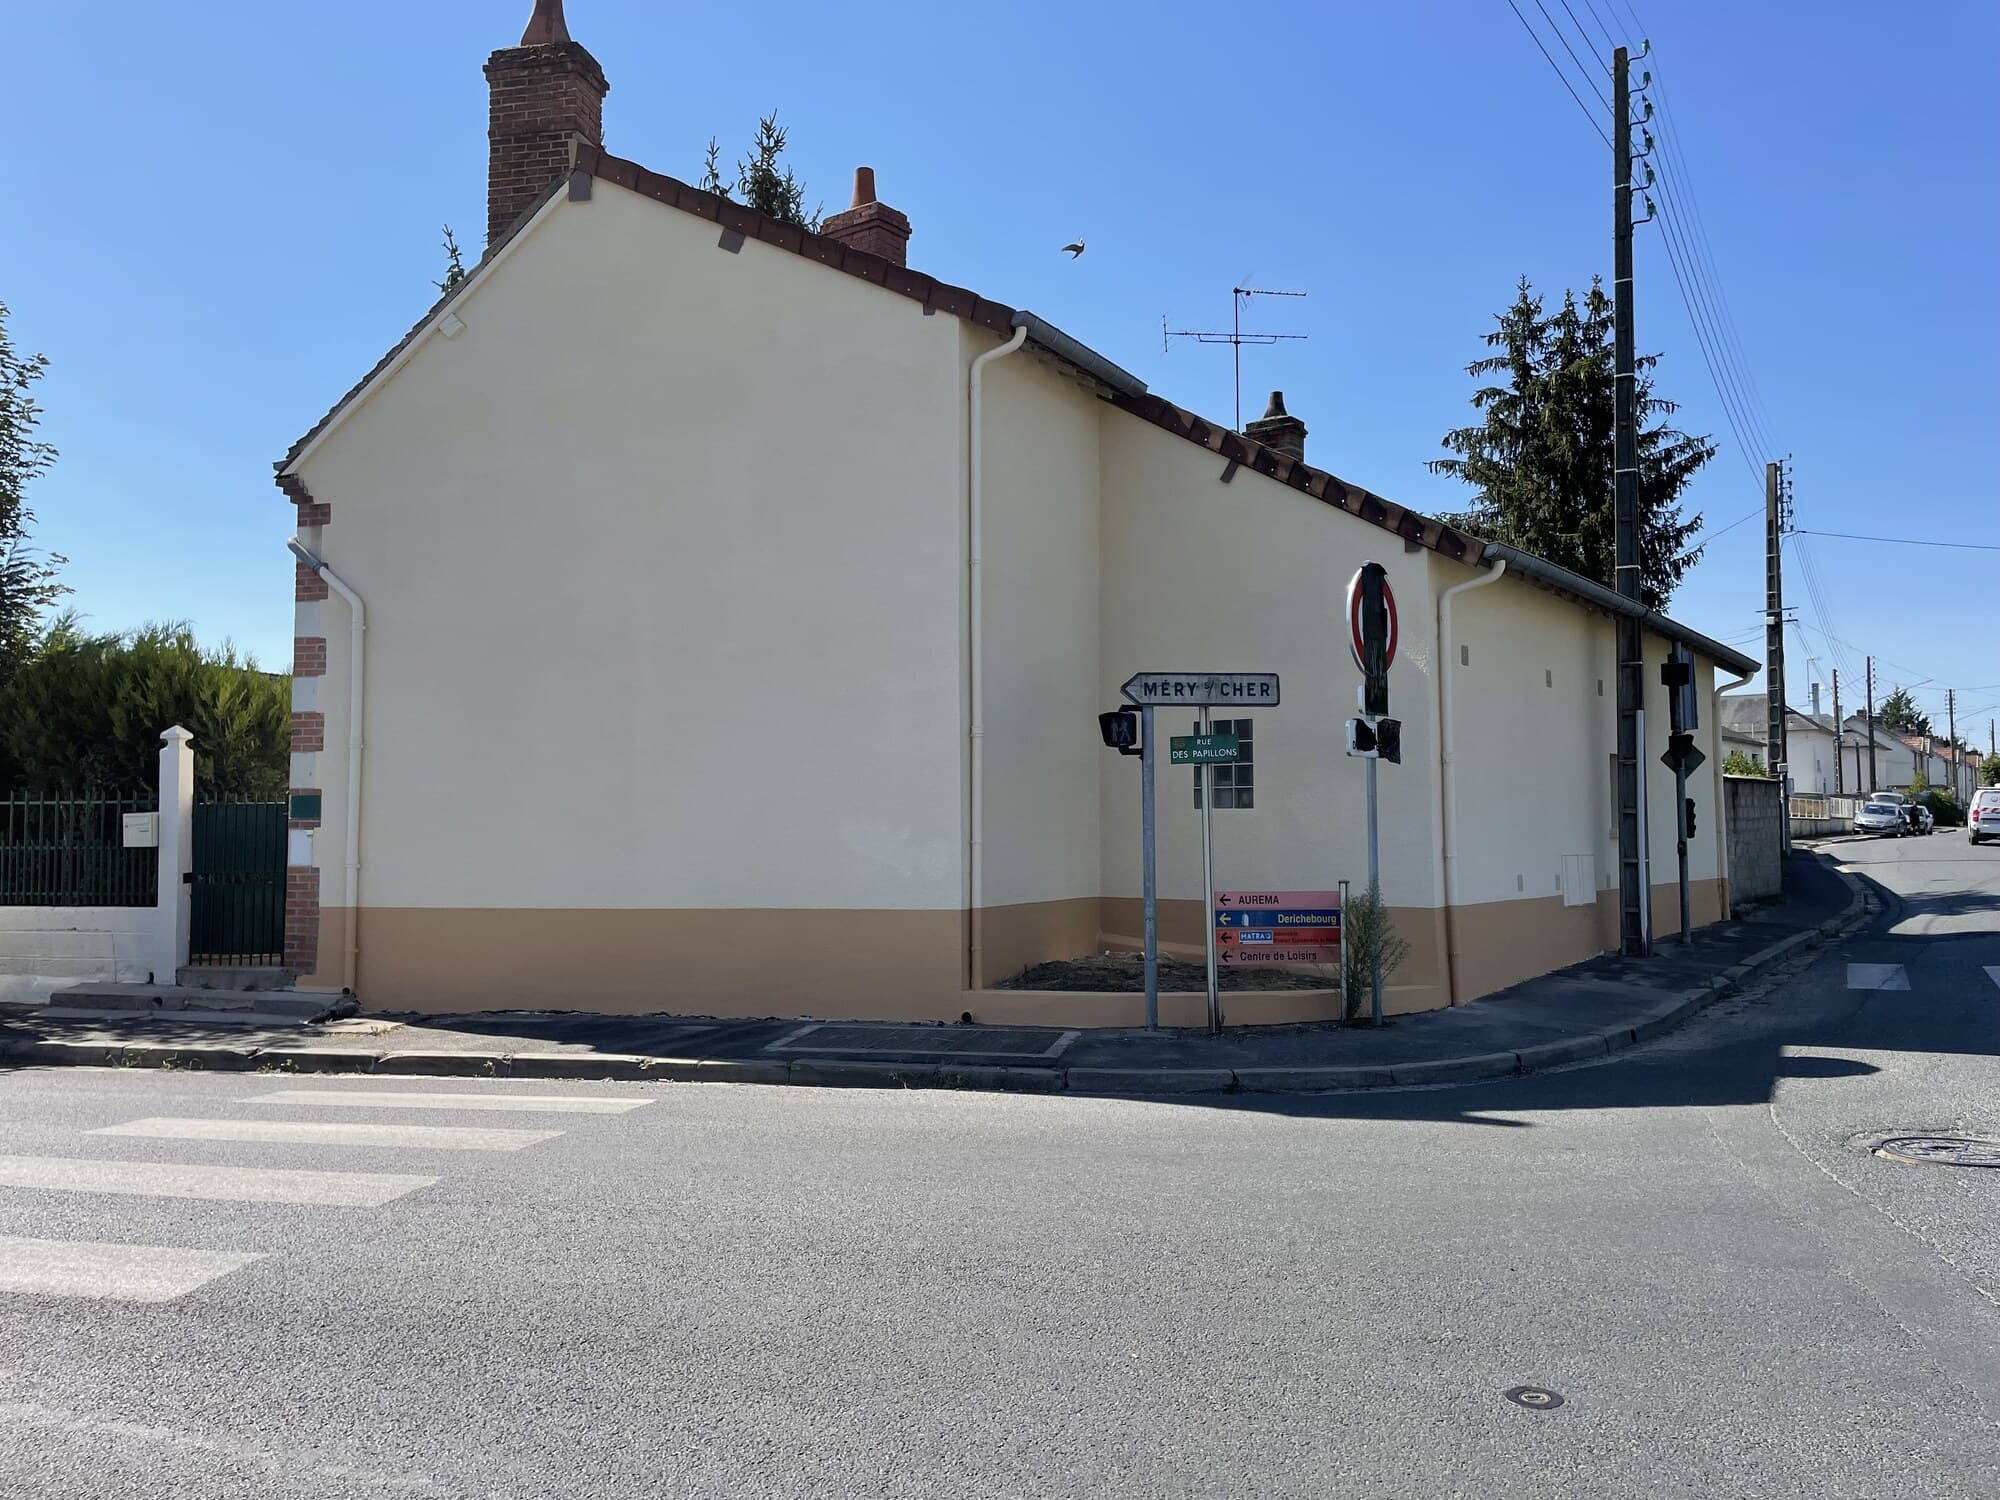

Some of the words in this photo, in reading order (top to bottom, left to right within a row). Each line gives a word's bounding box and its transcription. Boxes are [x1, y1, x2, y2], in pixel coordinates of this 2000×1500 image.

[1143, 679, 1197, 697] MÉRY
[1220, 682, 1271, 697] CHER
[1196, 738, 1212, 746] RUE
[1172, 750, 1189, 759] DES
[1192, 748, 1238, 759] PAPILLONS
[1238, 895, 1280, 905] AUREMA
[1277, 913, 1337, 925] Derichebourg
[1239, 951, 1270, 961] Centre
[1273, 951, 1285, 961] de
[1287, 951, 1317, 961] Loisirs
